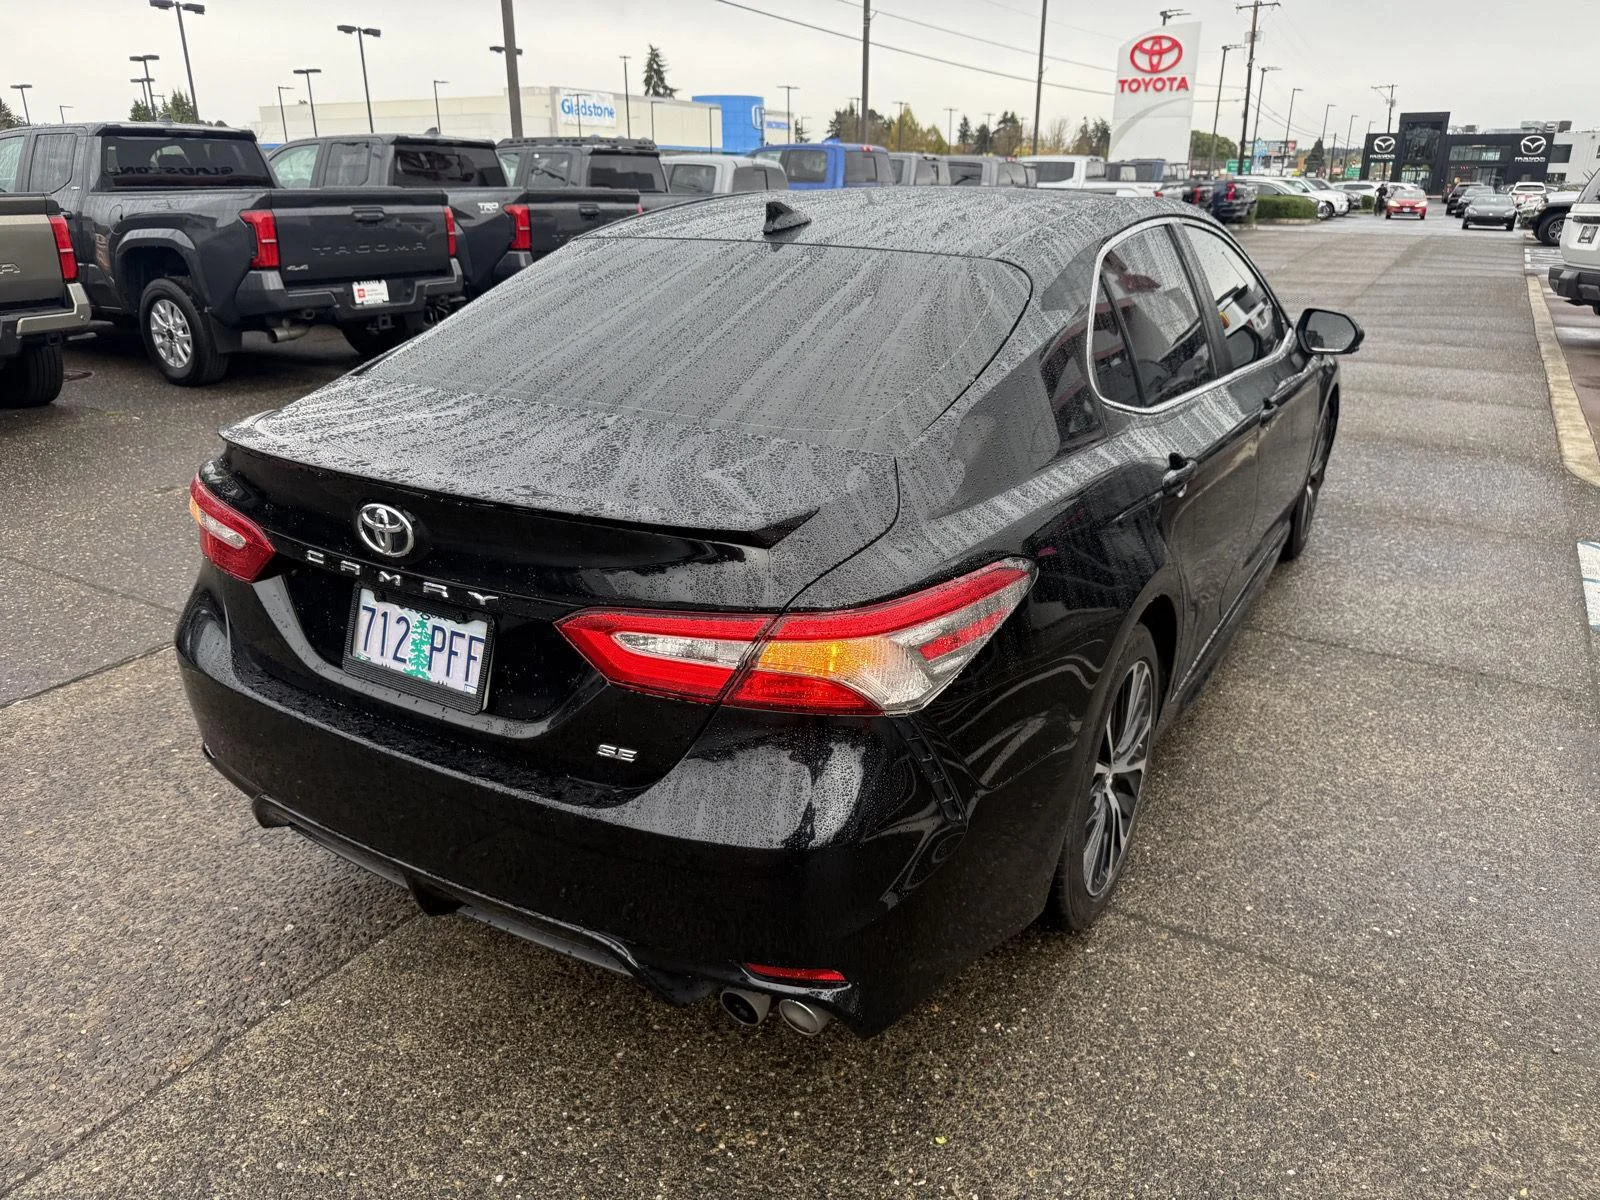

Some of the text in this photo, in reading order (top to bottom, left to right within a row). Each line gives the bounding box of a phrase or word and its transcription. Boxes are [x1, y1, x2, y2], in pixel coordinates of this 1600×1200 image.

[1117, 76, 1189, 94] TOYOTA
[561, 98, 615, 119] Gladstone
[477, 202, 499, 211] TRD
[312, 242, 427, 256] TACOMA
[306, 549, 499, 605] CAMRY
[361, 605, 486, 682] 712 PFF
[596, 744, 638, 763] SE
